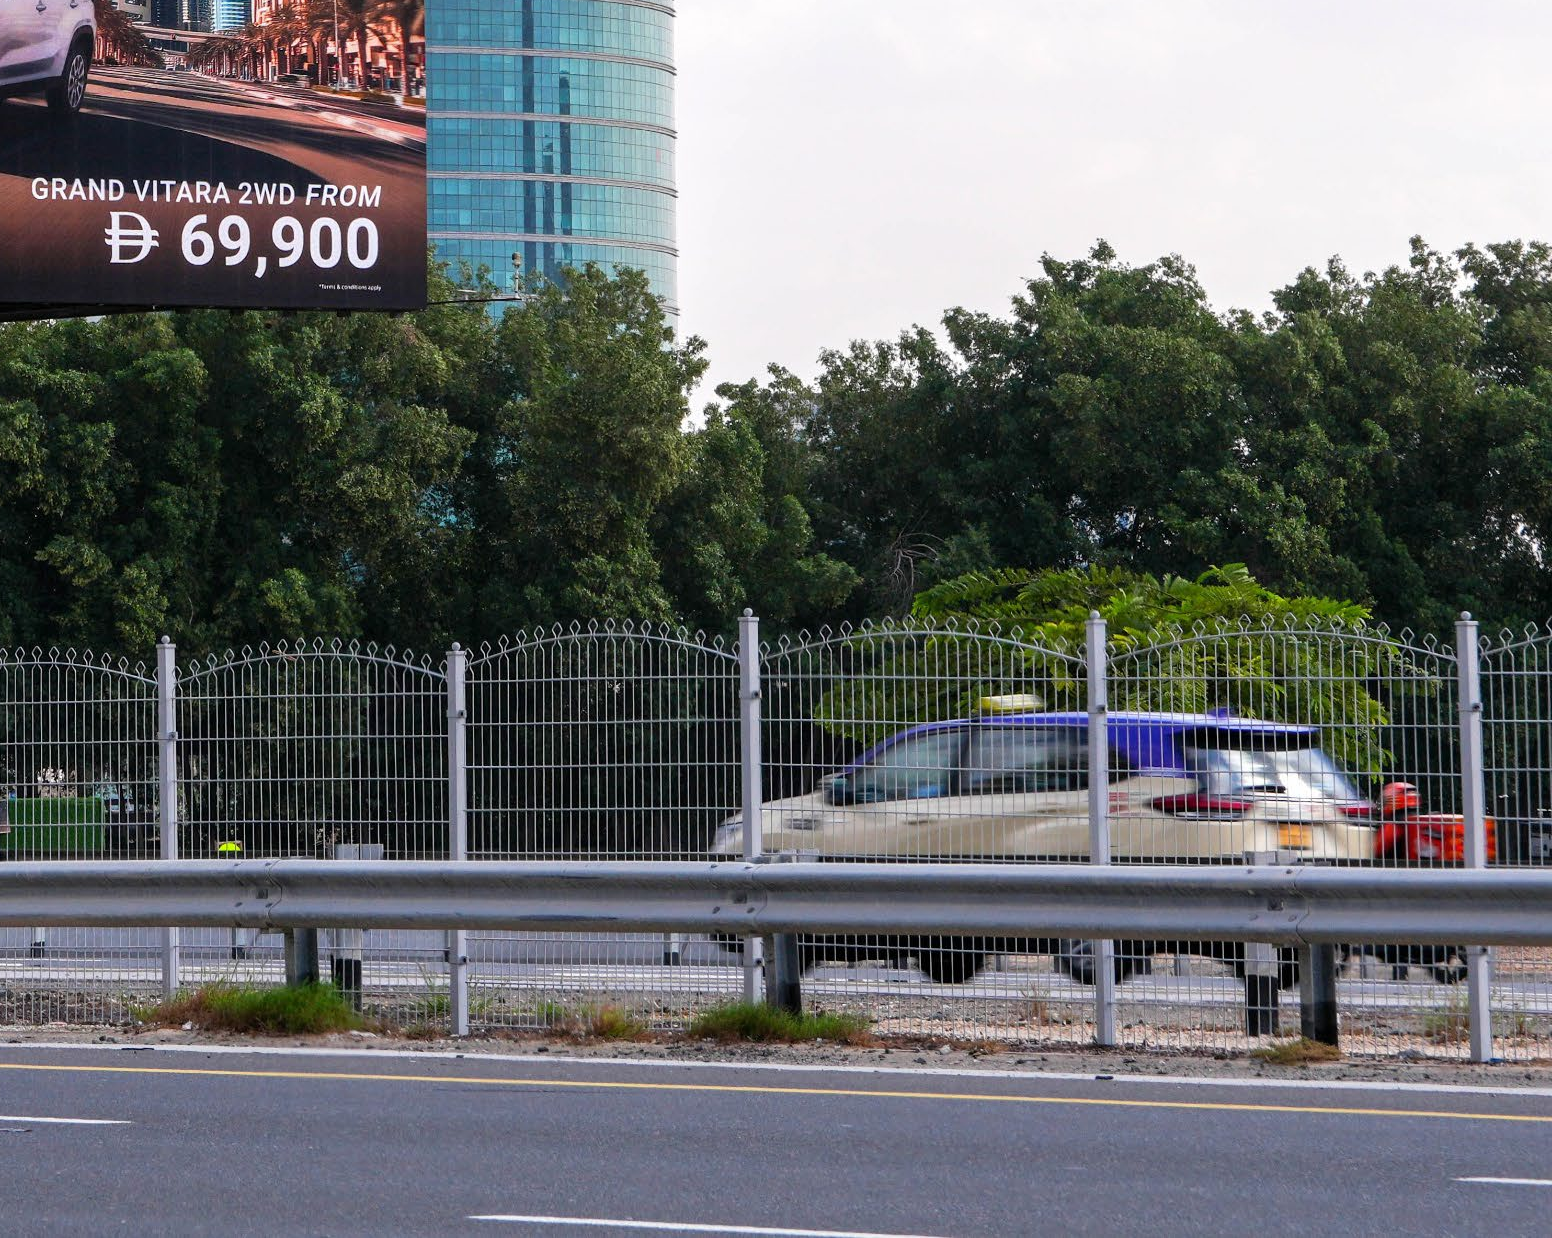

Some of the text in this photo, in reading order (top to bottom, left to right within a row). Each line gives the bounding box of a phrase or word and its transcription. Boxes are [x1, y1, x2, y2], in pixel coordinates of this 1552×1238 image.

[31, 177, 383, 208] GRAND VITARA 2WD FROM
[180, 213, 379, 279] 69,900
